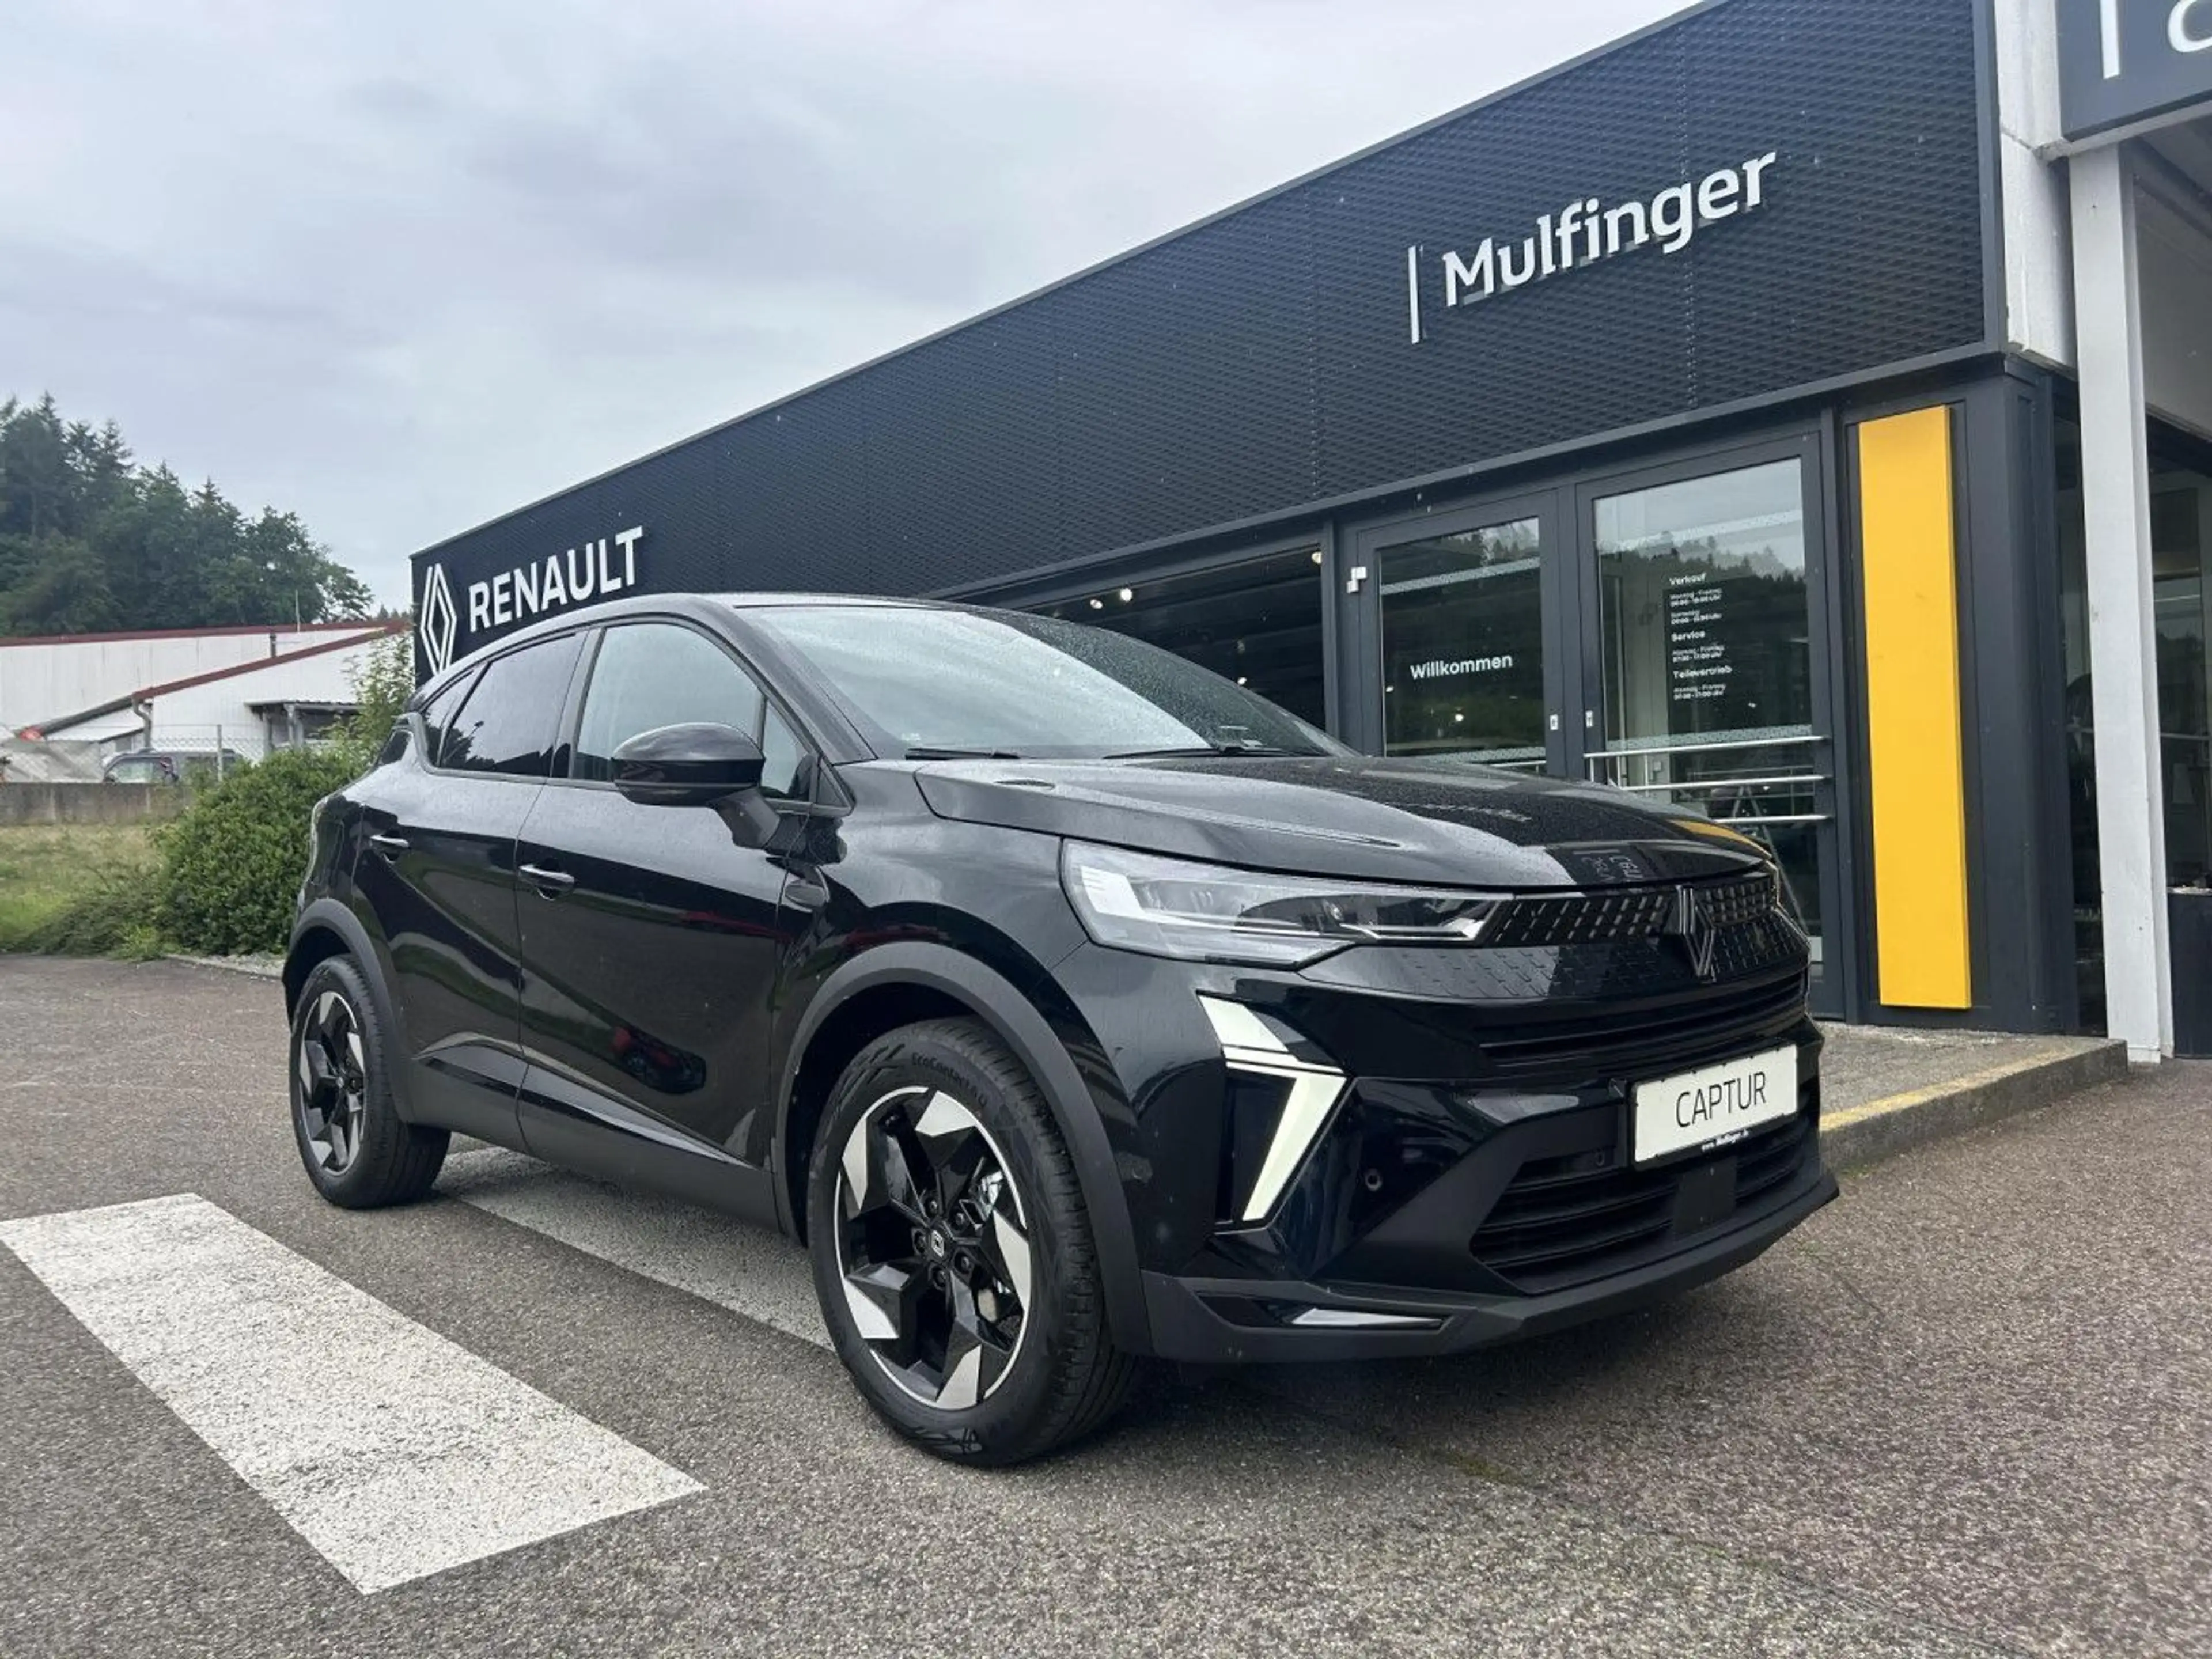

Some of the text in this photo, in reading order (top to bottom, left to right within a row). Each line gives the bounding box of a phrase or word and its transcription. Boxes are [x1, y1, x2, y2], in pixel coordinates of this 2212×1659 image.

[1442, 151, 1776, 308] Mulfinger
[468, 526, 643, 632] RENAULT
[1671, 631, 1705, 641] Service
[1410, 654, 1513, 680] Willkommen
[1676, 1071, 1767, 1127] CAPTUR
